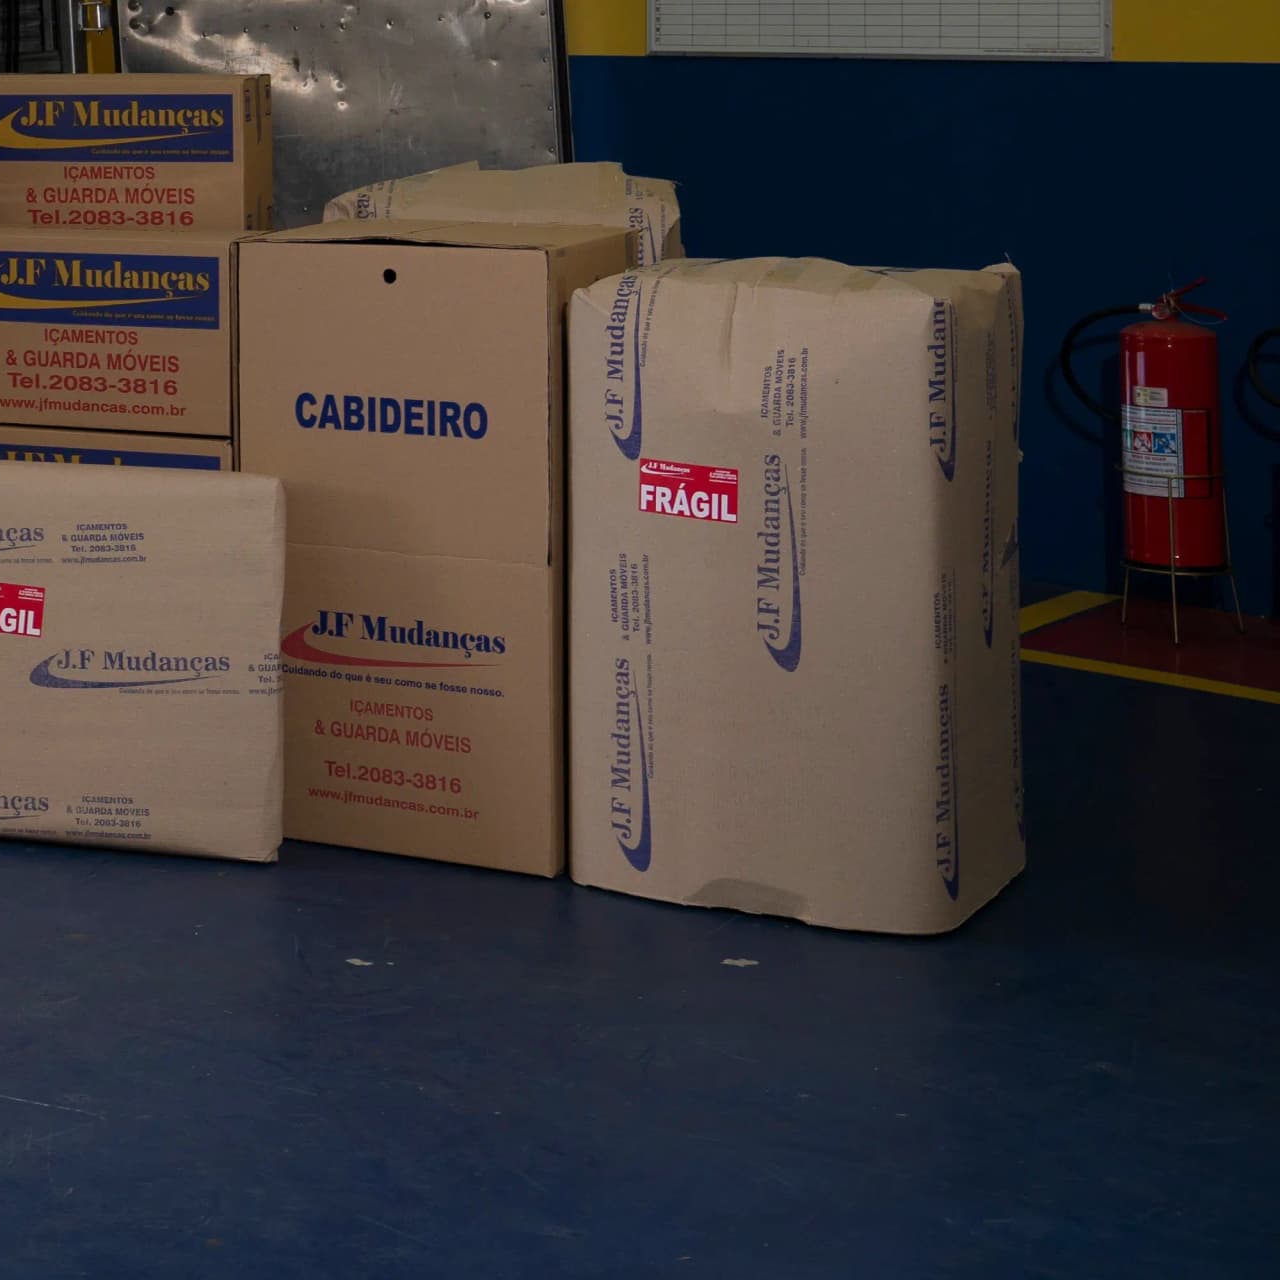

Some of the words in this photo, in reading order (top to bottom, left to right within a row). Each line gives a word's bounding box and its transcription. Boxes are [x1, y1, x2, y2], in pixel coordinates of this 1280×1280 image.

[21, 100, 64, 127] J.F
[71, 100, 224, 134] Mudanças
[63, 166, 155, 182] IÇAMENTOS
[26, 189, 37, 203] &
[44, 188, 119, 204] GUARDA
[125, 184, 195, 204] MÓVEIS
[27, 209, 194, 225] Tel.2083-3816
[1, 257, 46, 285] J.F
[53, 259, 210, 298] Mudanças
[44, 328, 138, 345] IÇAMENTOS
[605, 275, 639, 382] Mudanças
[6, 350, 17, 366] &
[24, 351, 100, 369] GUARDA
[107, 350, 179, 372] MÓVEIS
[7, 373, 178, 395] Tel.2083-3816
[0, 397, 186, 416] www.jfmudancas.com.br
[295, 392, 488, 440] CABIDEIRO
[640, 482, 737, 522] FRÁGIL
[757, 454, 786, 591] Mudanças
[312, 610, 354, 637] J.F
[360, 615, 506, 659] Mudanças
[57, 649, 95, 670] J.F
[103, 650, 230, 677] Mudanças
[282, 664, 327, 678] Cuidando
[330, 669, 343, 679] do
[345, 673, 363, 684] que
[374, 675, 392, 684] seu
[395, 679, 422, 689] como
[425, 681, 437, 690] se
[439, 682, 467, 694] fosse
[470, 687, 505, 698] nosso.
[350, 700, 433, 721] IÇAMENTOS
[610, 657, 636, 792] Mudanças
[315, 720, 325, 735] &
[331, 721, 400, 745] GUARDA
[406, 729, 471, 753] MÓVEIS
[308, 787, 480, 820] www.jfmudancas.com.br
